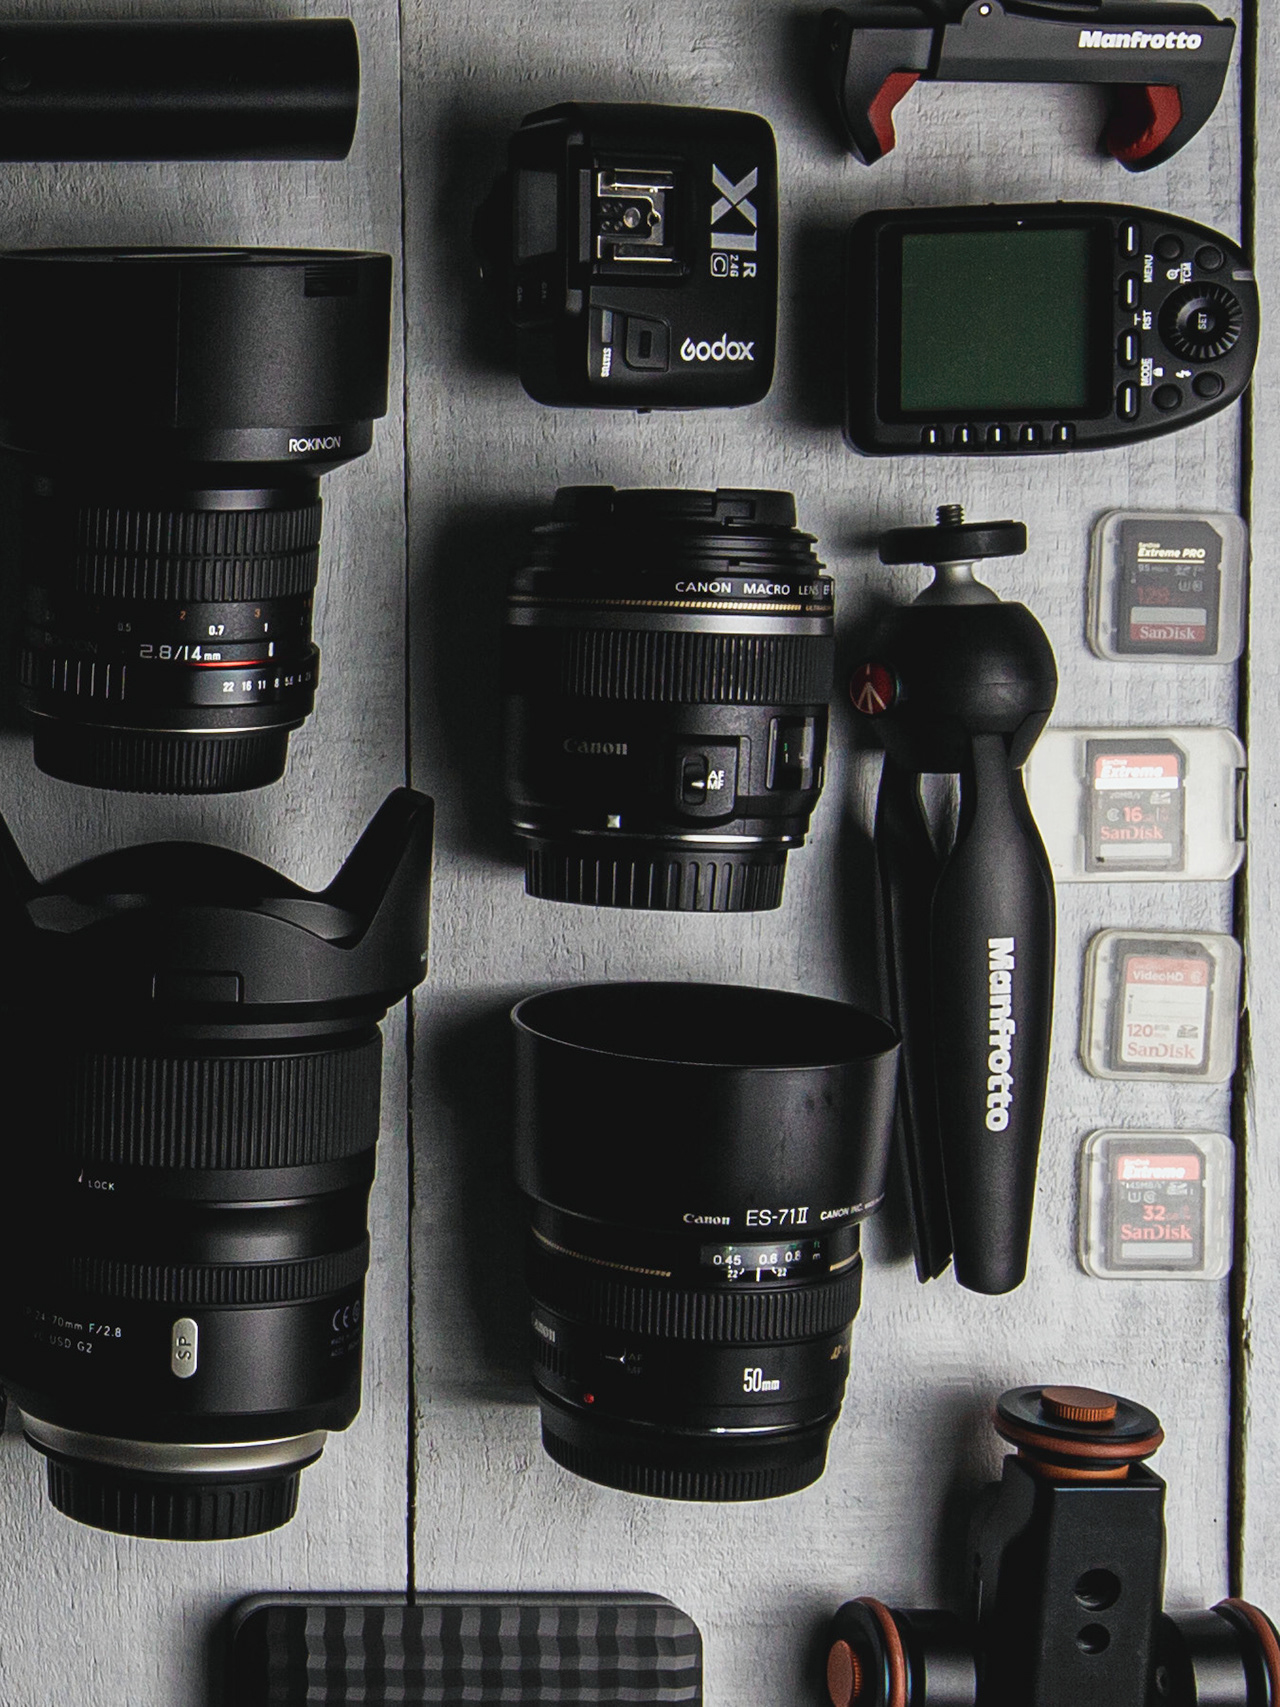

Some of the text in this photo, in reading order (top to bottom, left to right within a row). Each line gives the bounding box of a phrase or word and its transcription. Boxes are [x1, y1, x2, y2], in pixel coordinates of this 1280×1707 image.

[1078, 29, 1203, 50] Manfrotto
[742, 260, 758, 279] R
[1144, 254, 1154, 284] MENU
[1142, 310, 1152, 331] RST
[1197, 312, 1207, 330] SET
[679, 333, 756, 362] Godox
[288, 435, 342, 453] ROKINON
[1137, 548, 1206, 559] Extreme PRO
[674, 581, 732, 594] CANON
[743, 582, 790, 596] MACRO
[208, 624, 226, 637] 0.7
[1140, 626, 1196, 640] SanDisk
[222, 681, 235, 693] 22
[257, 679, 267, 690] 11
[561, 736, 629, 757] Canon
[707, 770, 725, 780] AF
[1100, 765, 1164, 779] Extreme
[1123, 806, 1143, 823] 16
[1100, 825, 1164, 841] SanDisk
[985, 936, 1017, 1133] Manfrotto
[1127, 1023, 1154, 1038] 120
[1127, 1041, 1196, 1060] SanDisk
[1123, 1166, 1186, 1180] Extreme
[88, 1179, 116, 1192] LOCK
[682, 1212, 732, 1227] Canon
[819, 1206, 850, 1222] CANON
[1143, 1204, 1166, 1222] 32
[1121, 1223, 1193, 1241] SanDisk
[712, 1254, 742, 1266] 0.45
[758, 1253, 779, 1265] 0.6
[88, 1322, 123, 1338] F/2.8
[175, 1336, 193, 1361] SP
[742, 1366, 781, 1393] 50mm
